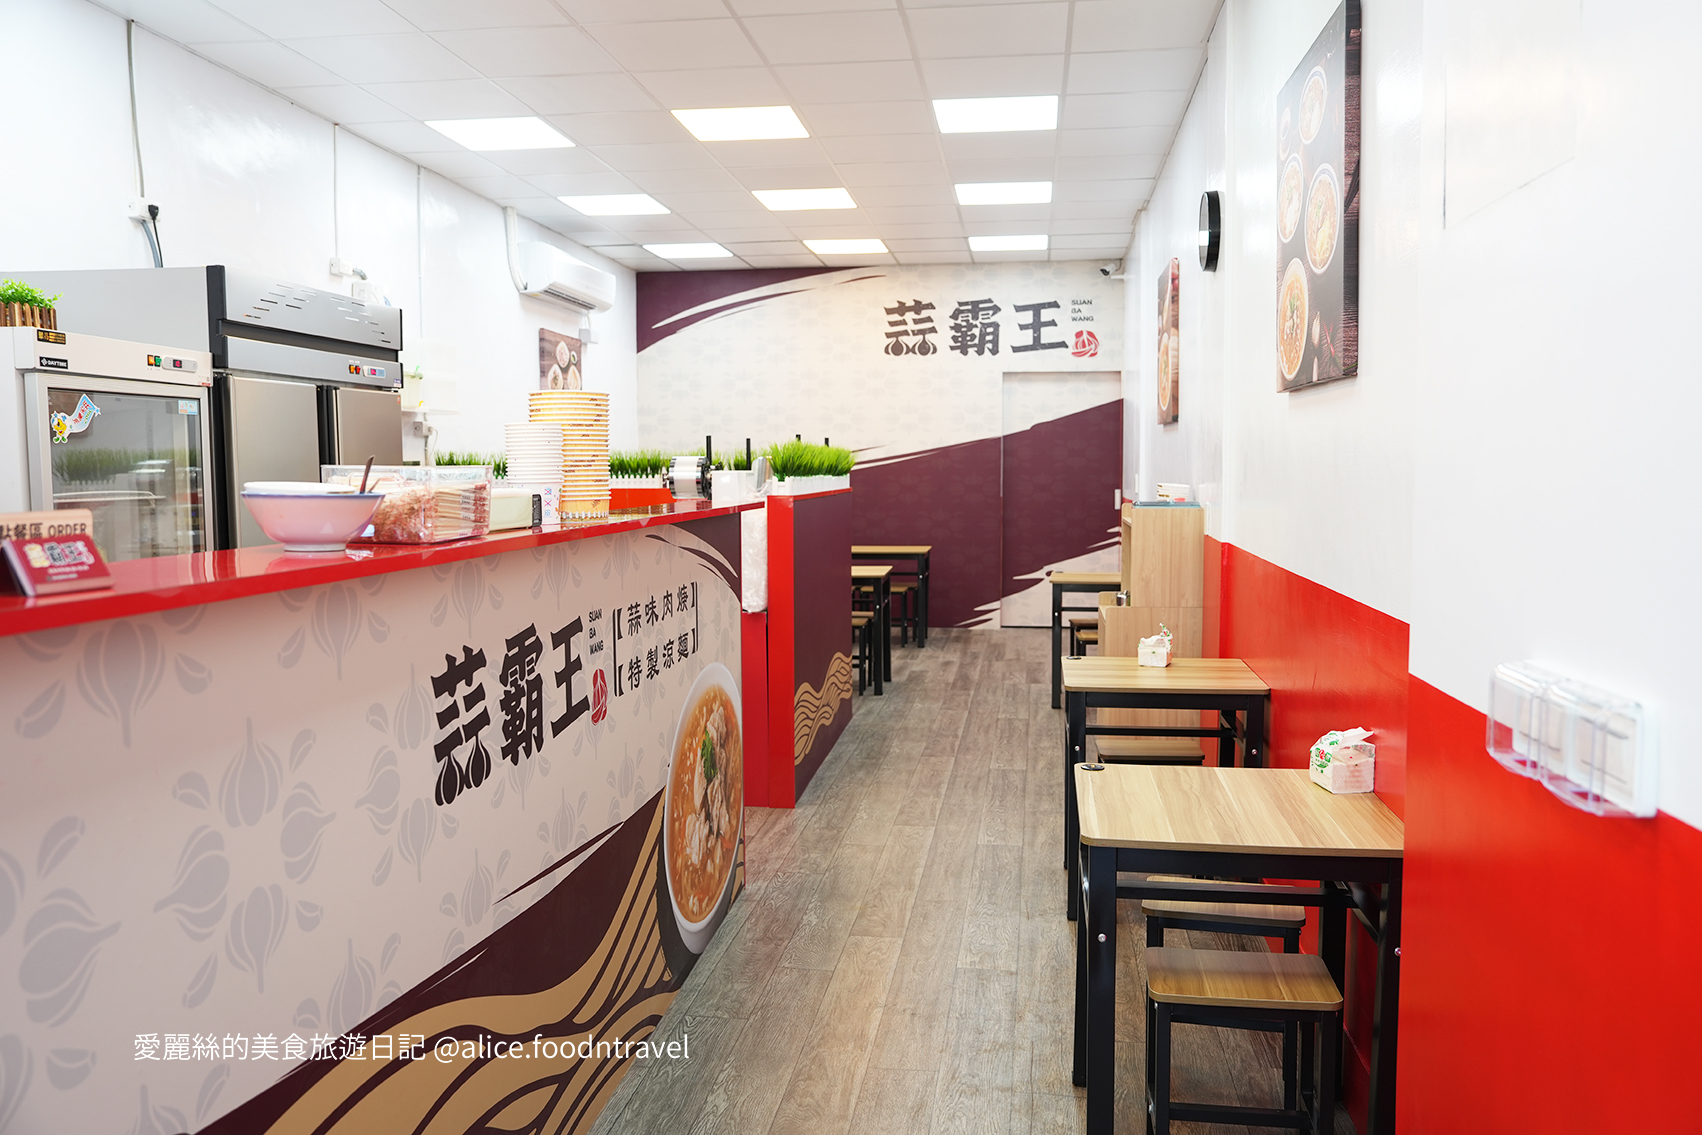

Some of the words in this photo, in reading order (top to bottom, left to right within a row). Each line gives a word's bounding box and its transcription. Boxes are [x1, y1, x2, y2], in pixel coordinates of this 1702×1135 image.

[883, 297, 1070, 357] 蒜霸王
[588, 608, 603, 623] SUAN
[588, 627, 597, 639] BA
[589, 640, 604, 656] WANG
[430, 616, 591, 807] 蒜霸王
